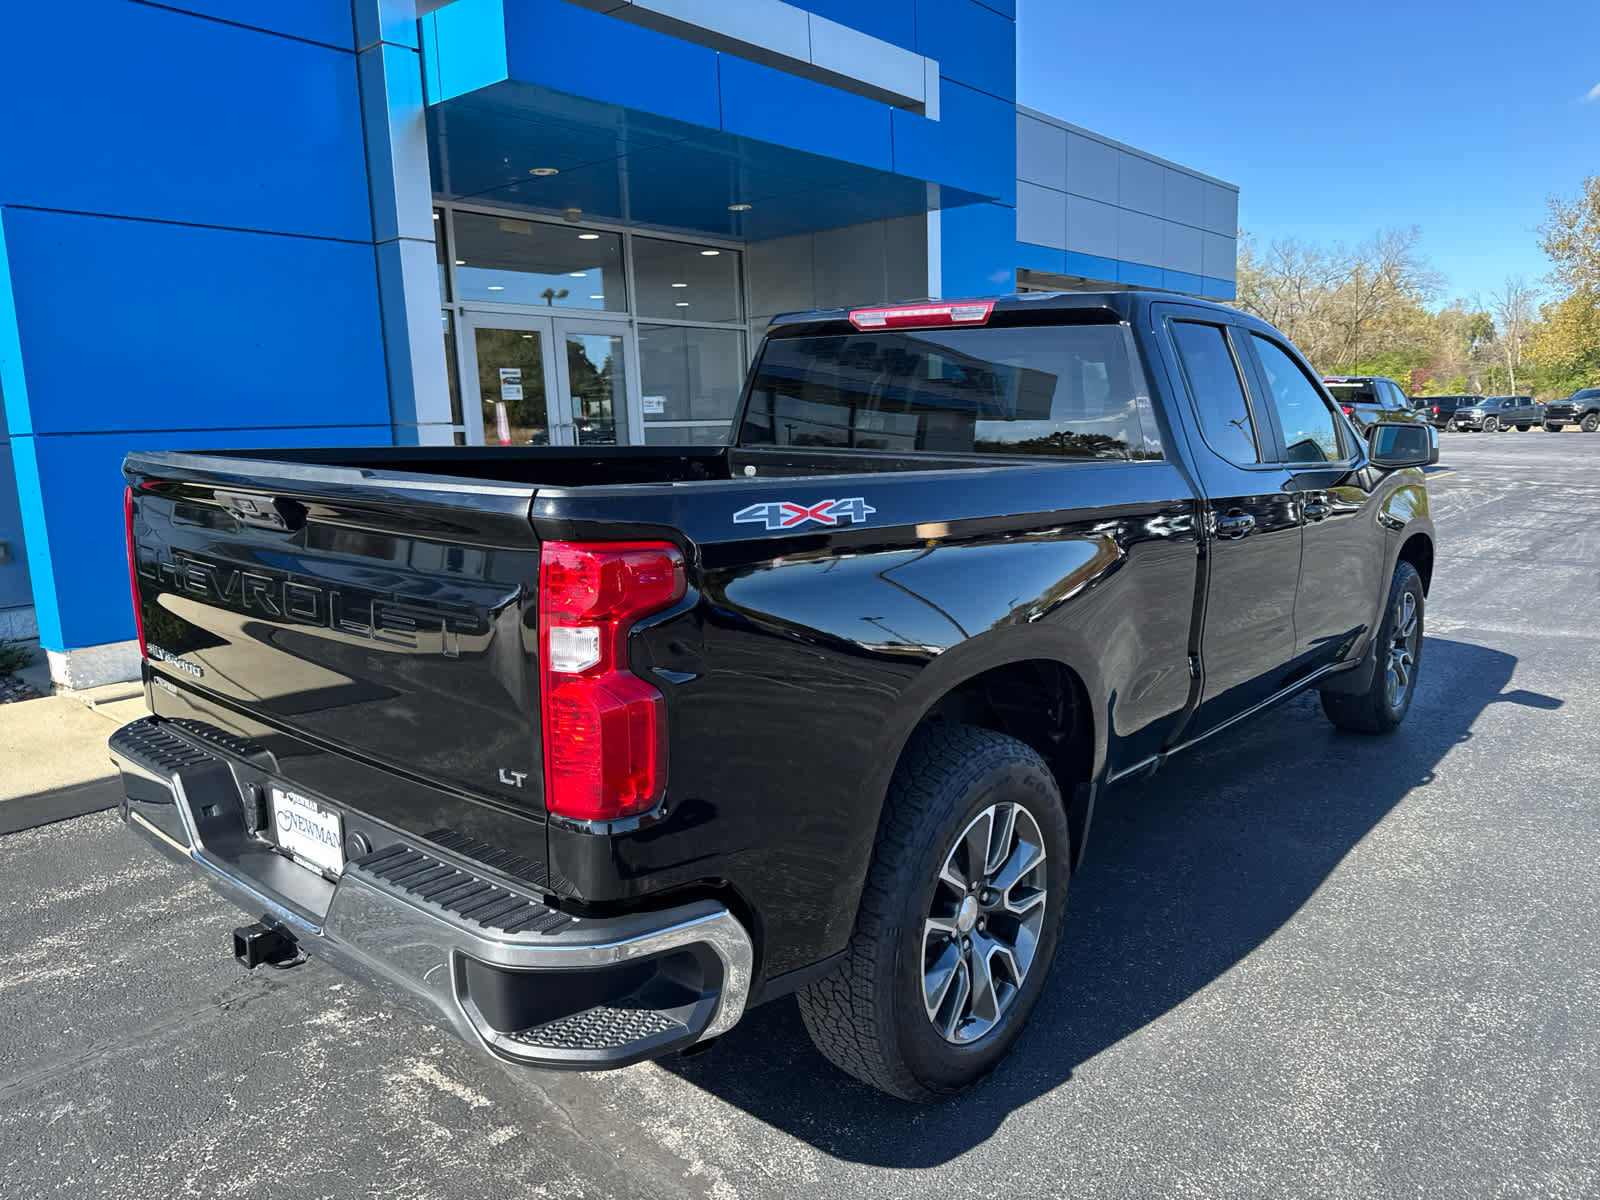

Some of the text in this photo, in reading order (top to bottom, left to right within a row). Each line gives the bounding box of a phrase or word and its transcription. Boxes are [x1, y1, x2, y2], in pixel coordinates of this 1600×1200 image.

[137, 543, 480, 658] CHEVROLET
[499, 768, 528, 788] LT
[277, 809, 341, 849] NEWMAN
